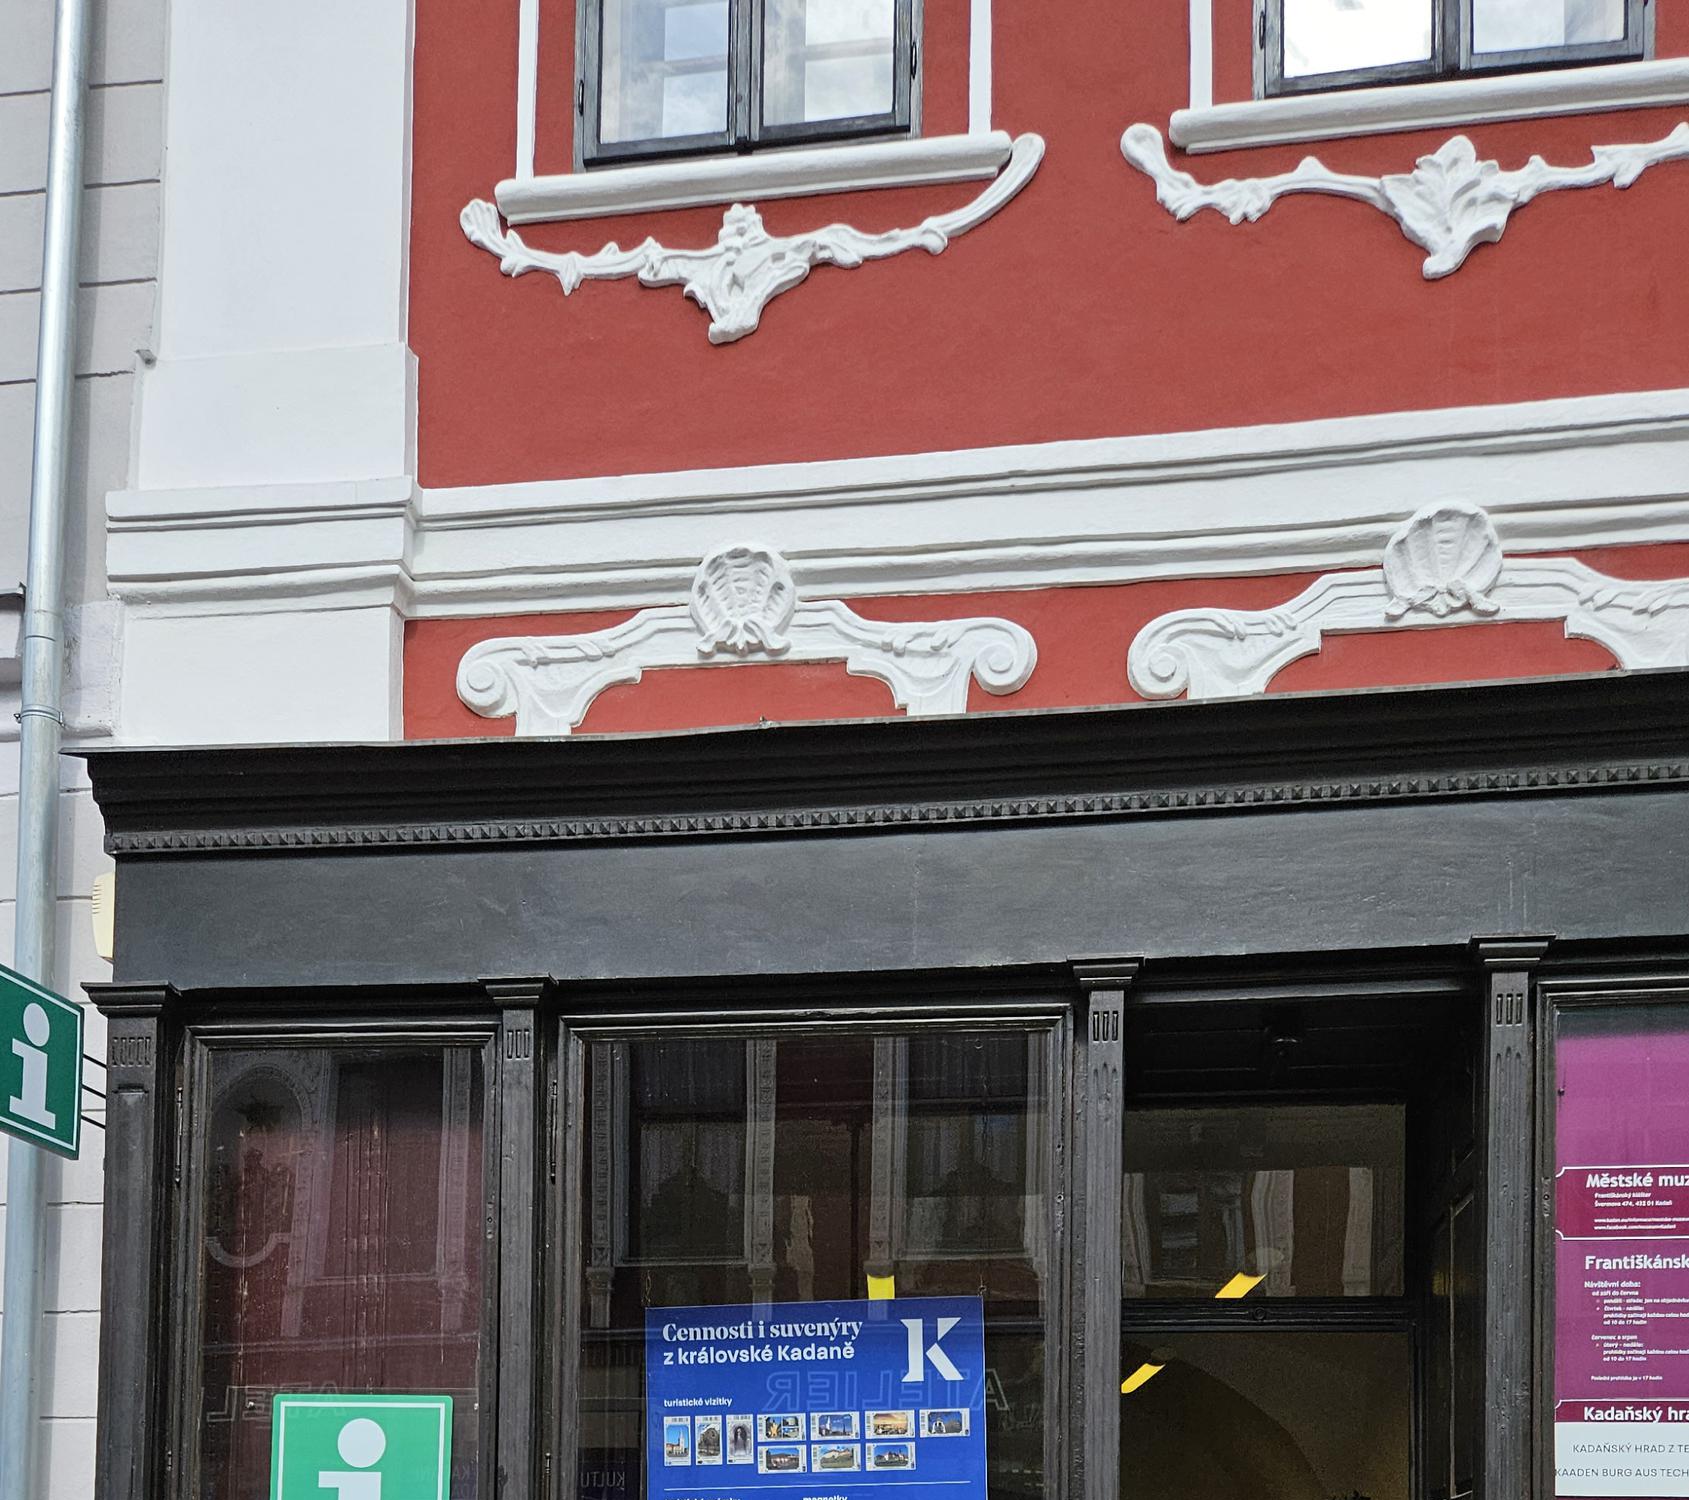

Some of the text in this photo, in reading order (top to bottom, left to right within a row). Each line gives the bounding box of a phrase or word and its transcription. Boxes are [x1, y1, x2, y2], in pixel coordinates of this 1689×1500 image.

[1586, 1172, 1653, 1188] Městské
[1584, 1280, 1619, 1288] Návštěvní
[663, 1318, 863, 1341] Cennosti i suvenýry
[664, 1342, 855, 1365] z královské Kadaně
[664, 1397, 732, 1407] turistické vizitky
[1584, 1406, 1663, 1423] Kadaňský
[1573, 1442, 1631, 1452] KADAŇSKÝ
[1602, 1468, 1632, 1477] BURG
[1635, 1468, 1657, 1477] AUS
